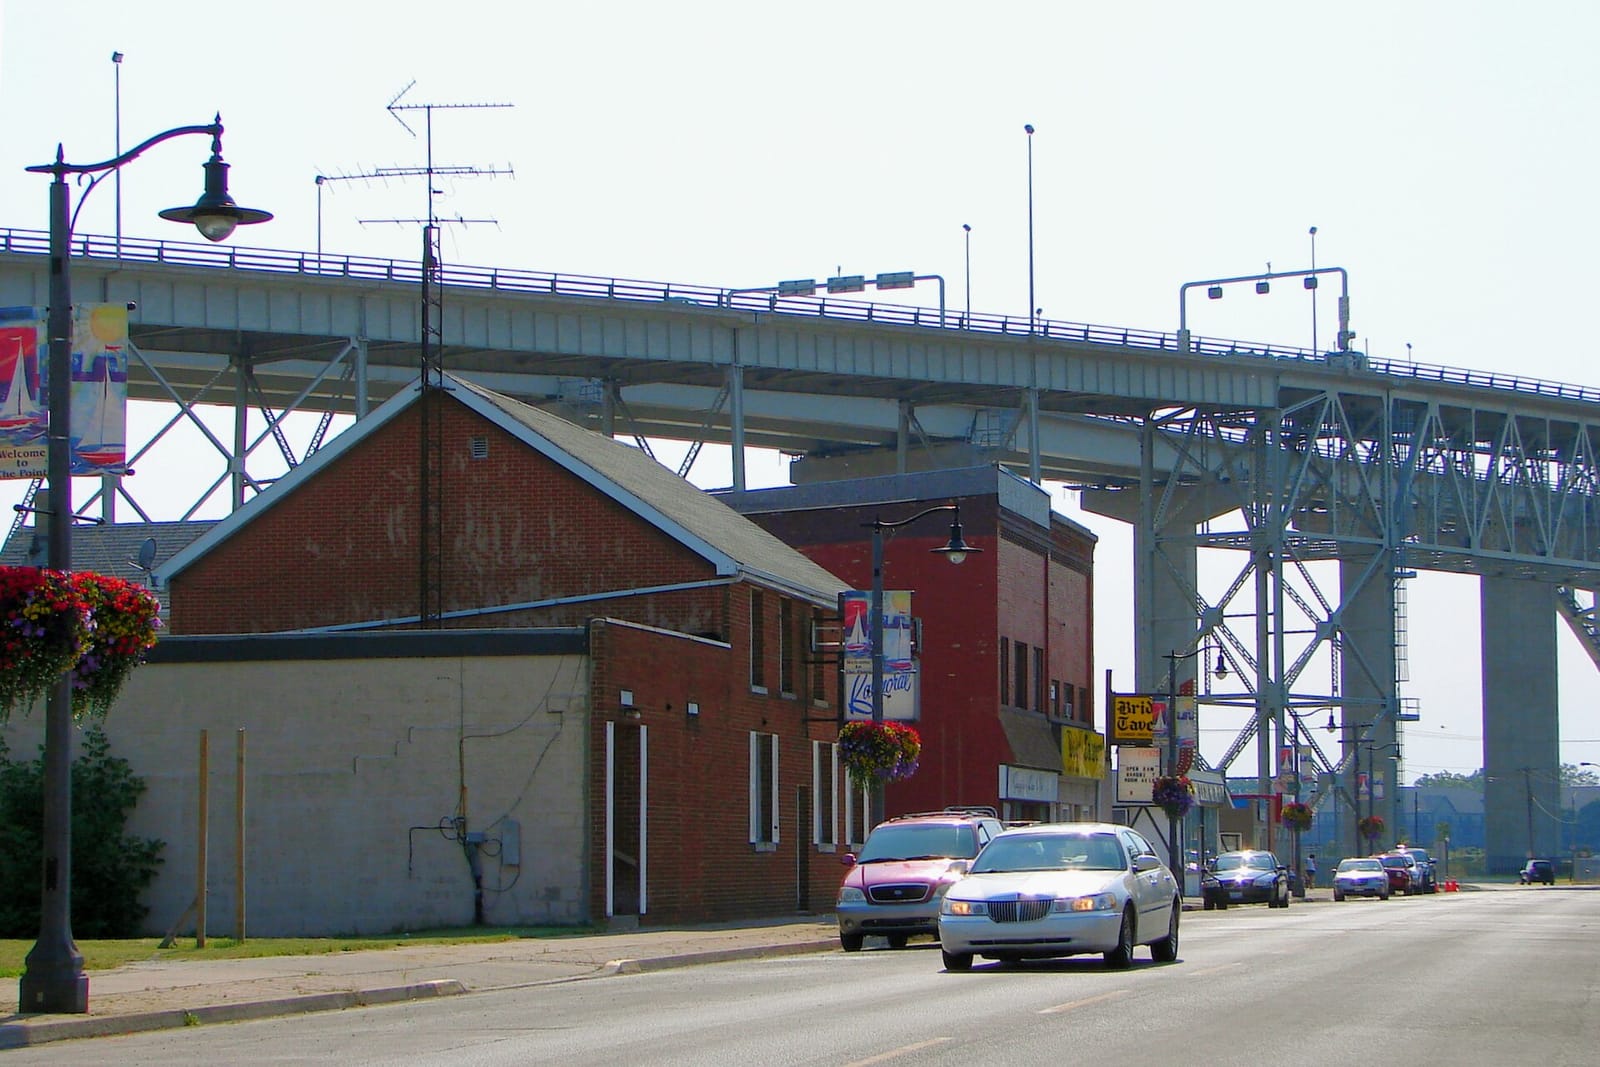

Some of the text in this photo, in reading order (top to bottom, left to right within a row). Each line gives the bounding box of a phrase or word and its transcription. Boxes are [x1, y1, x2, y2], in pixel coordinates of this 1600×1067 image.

[16, 459, 28, 467] to
[20, 469, 47, 477] Point
[1117, 700, 1153, 715] Brid
[1117, 716, 1153, 732] Tave
